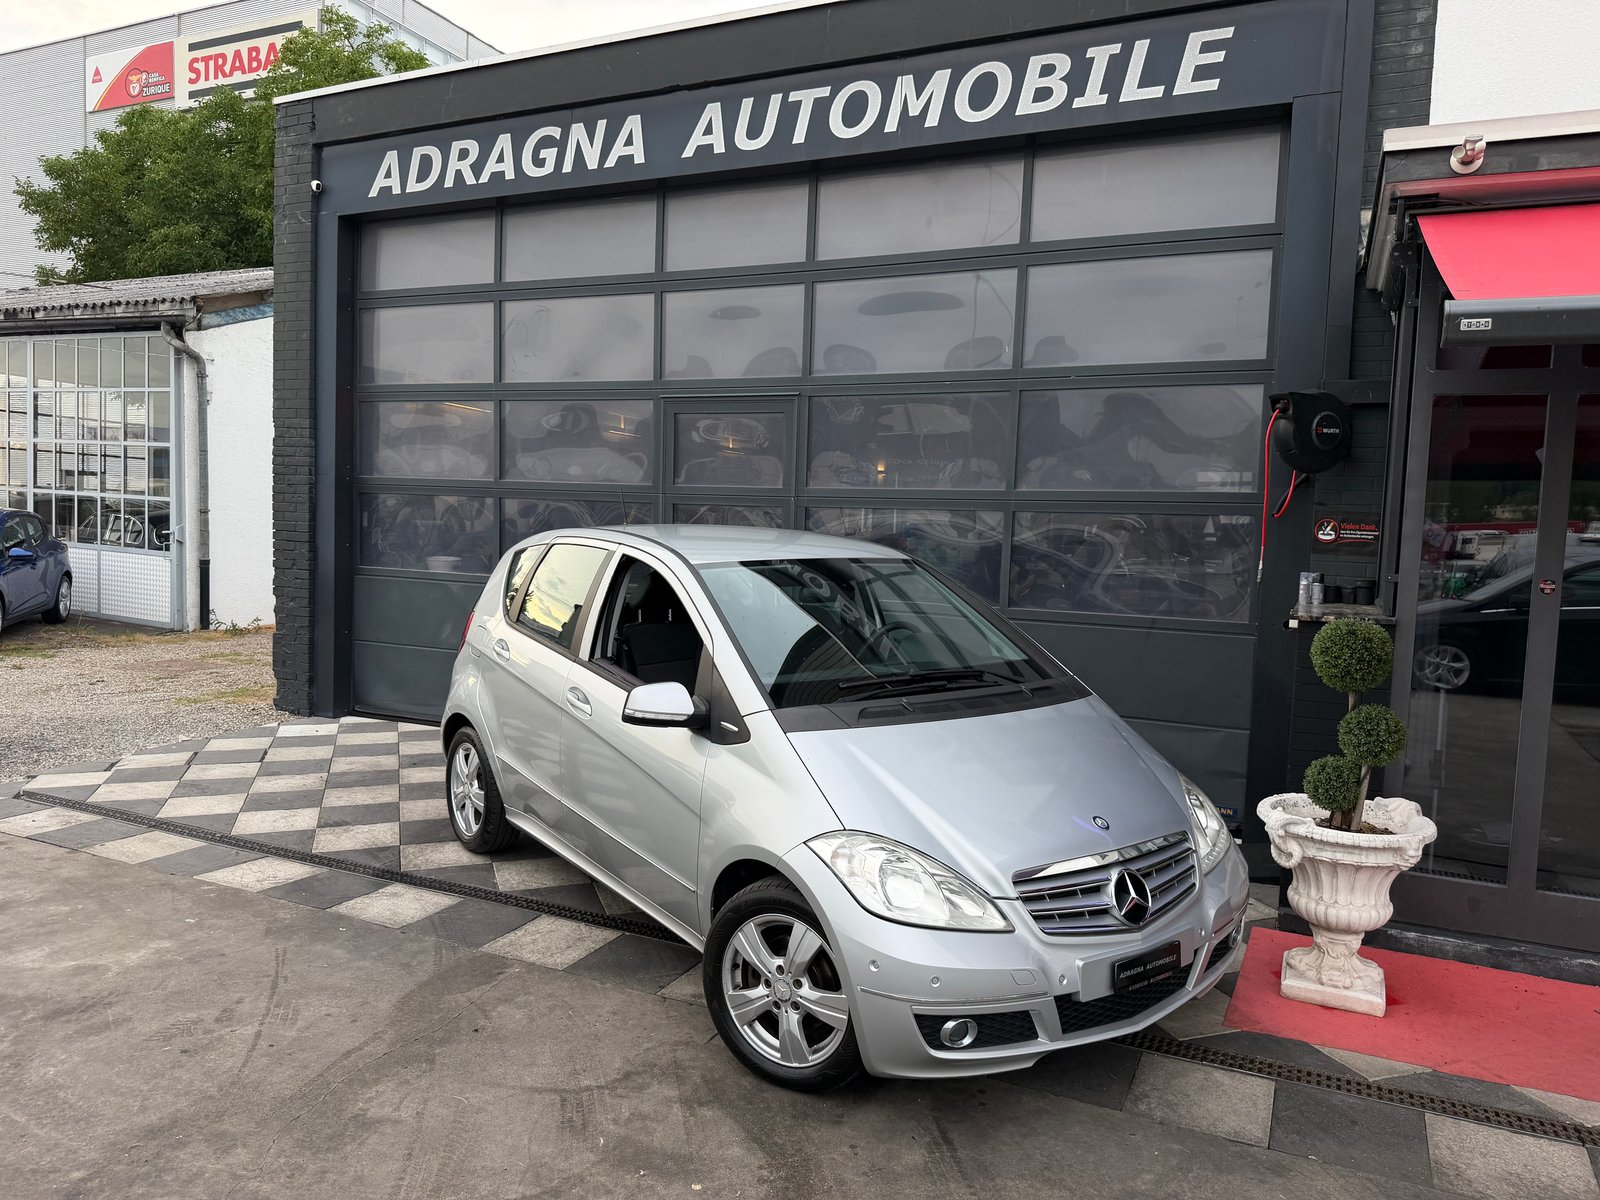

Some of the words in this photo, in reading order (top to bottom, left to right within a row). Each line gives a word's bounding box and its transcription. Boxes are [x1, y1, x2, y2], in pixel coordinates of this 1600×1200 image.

[188, 42, 280, 85] STRABA
[142, 83, 171, 97] ZURIQUE
[367, 114, 645, 198] ADRAGNA
[681, 26, 1235, 159] AUTOMOBILE
[1341, 522, 1360, 530] Vielen
[1216, 806, 1233, 815] ANN
[1120, 965, 1144, 979] ADRAGNA
[1146, 953, 1177, 970] AUTOMOBILE
